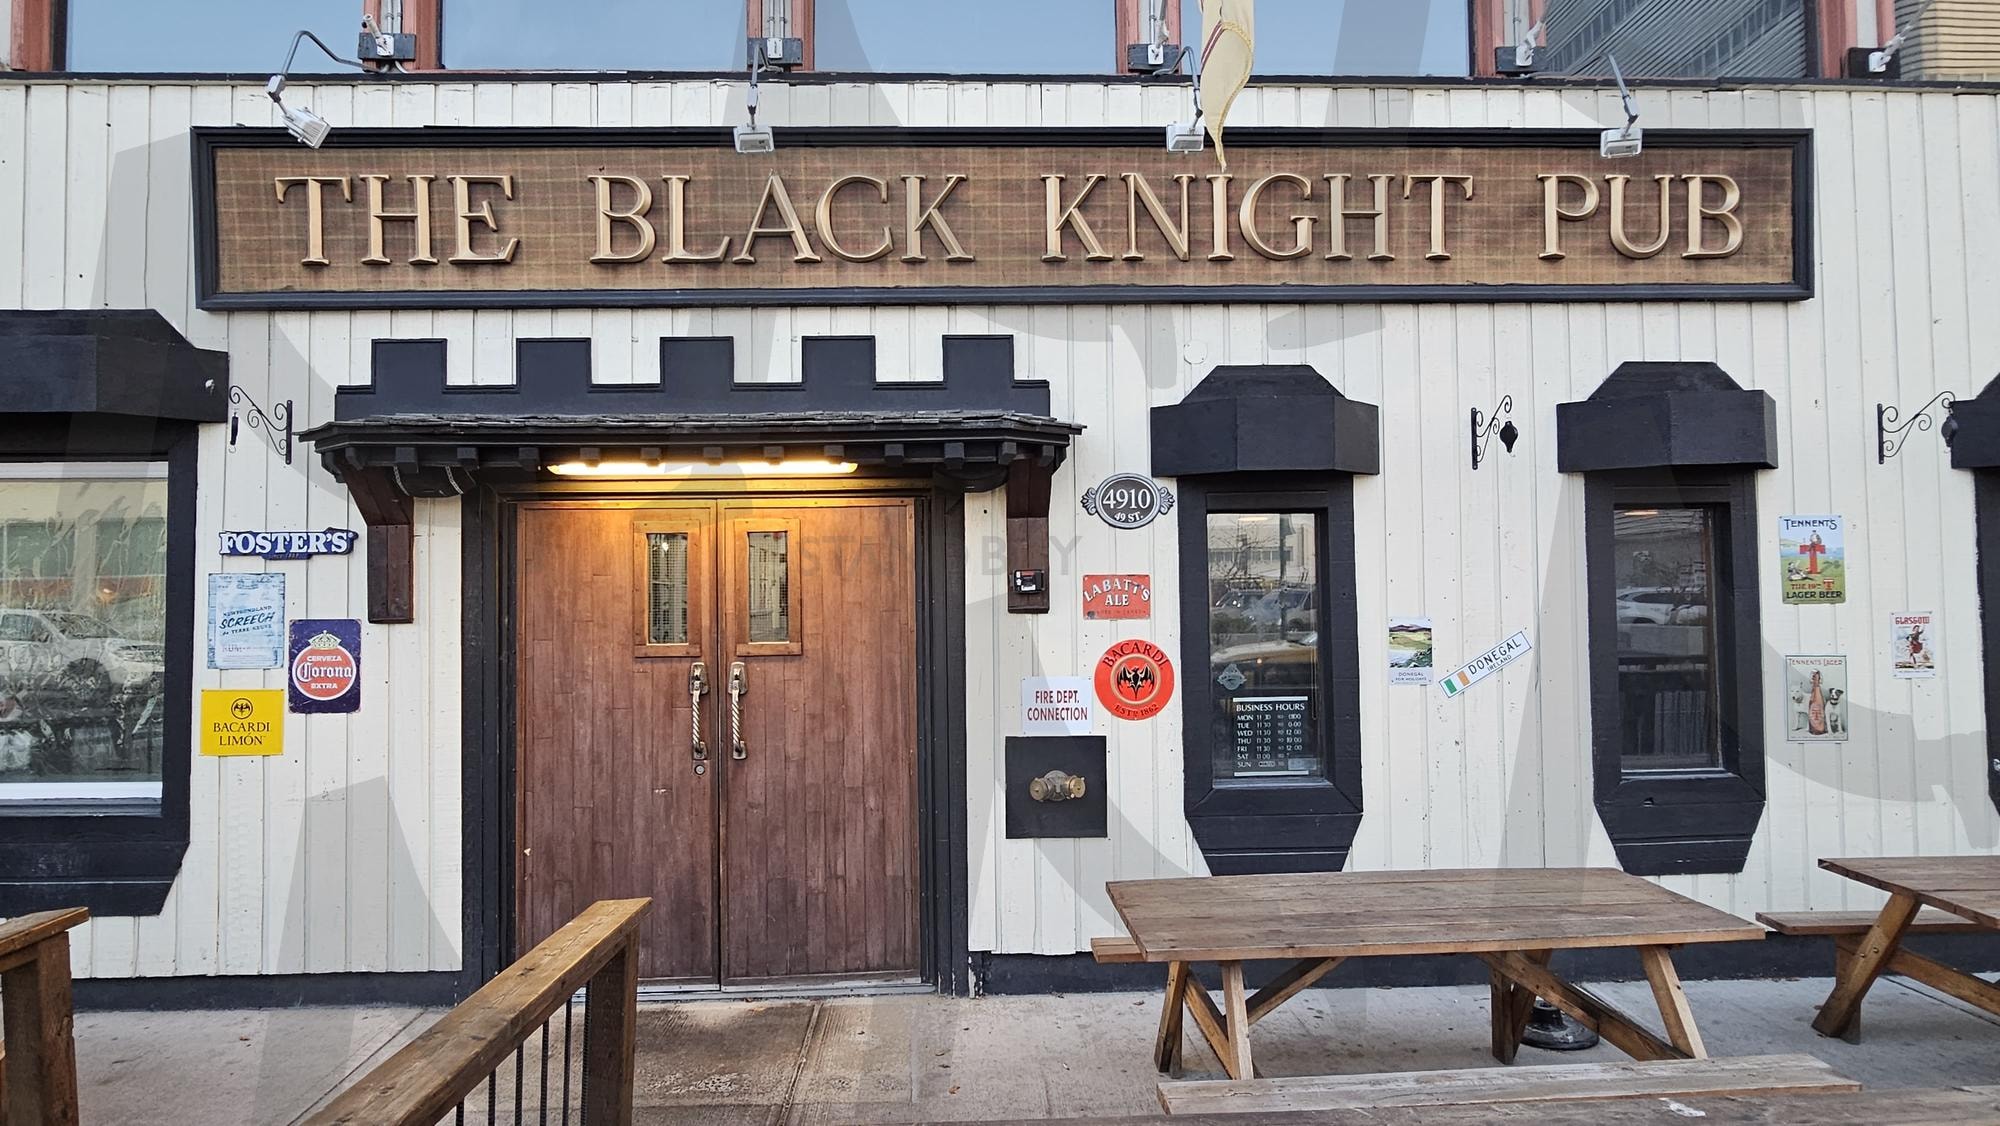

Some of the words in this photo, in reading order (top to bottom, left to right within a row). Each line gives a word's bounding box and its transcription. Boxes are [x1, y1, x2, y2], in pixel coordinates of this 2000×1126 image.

[274, 173, 520, 267] THE
[587, 169, 977, 265] BLACK
[1039, 172, 1474, 264] KNIGHT
[1537, 172, 1744, 261] PUB
[1102, 488, 1151, 509] 4910
[1114, 512, 1126, 522] 49
[1127, 511, 1144, 523] ST.
[219, 532, 348, 554] FOSTER'S
[1083, 578, 1150, 602] LABATT'S
[1786, 591, 1817, 599] LAGER
[1819, 590, 1843, 599] BEER
[1104, 594, 1130, 606] ALE
[218, 611, 276, 630] SCREECH
[1895, 616, 1930, 625] GLASGOW
[306, 655, 343, 663] CERVEZA
[1102, 641, 1170, 669] BACARDI
[1468, 638, 1522, 676] DONEGAL
[1487, 654, 1513, 672] IRELAND
[296, 662, 353, 683] Corona
[310, 682, 339, 690] EXTRA
[1035, 690, 1054, 704] FIRE
[1056, 690, 1080, 704] DEPT.
[1236, 703, 1273, 712] BUSINESS
[1275, 702, 1306, 712] HOURS
[1027, 707, 1089, 722] CONNECTION
[213, 721, 270, 733] BACARDI
[219, 733, 263, 746] LIMÓN
